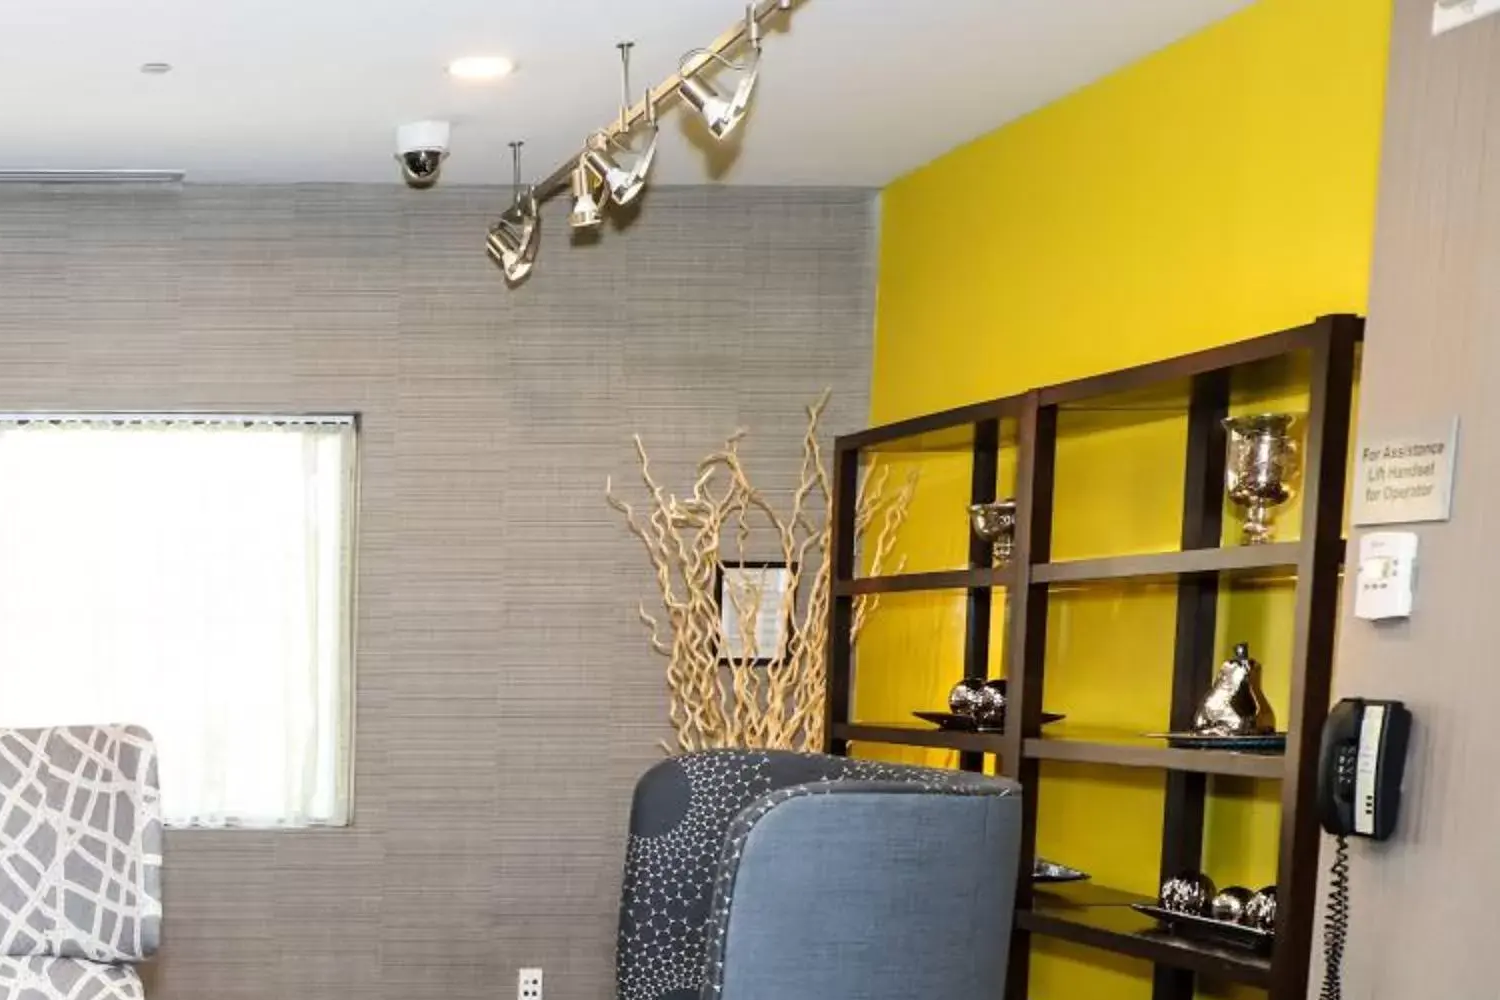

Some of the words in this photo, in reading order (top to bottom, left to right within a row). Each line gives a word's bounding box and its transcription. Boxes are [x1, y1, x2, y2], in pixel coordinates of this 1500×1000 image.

[1363, 447, 1381, 462] For
[1383, 443, 1445, 459] Assistance
[1388, 462, 1435, 479] Handset
[1366, 487, 1381, 502] for
[1383, 485, 1434, 500] Operator
